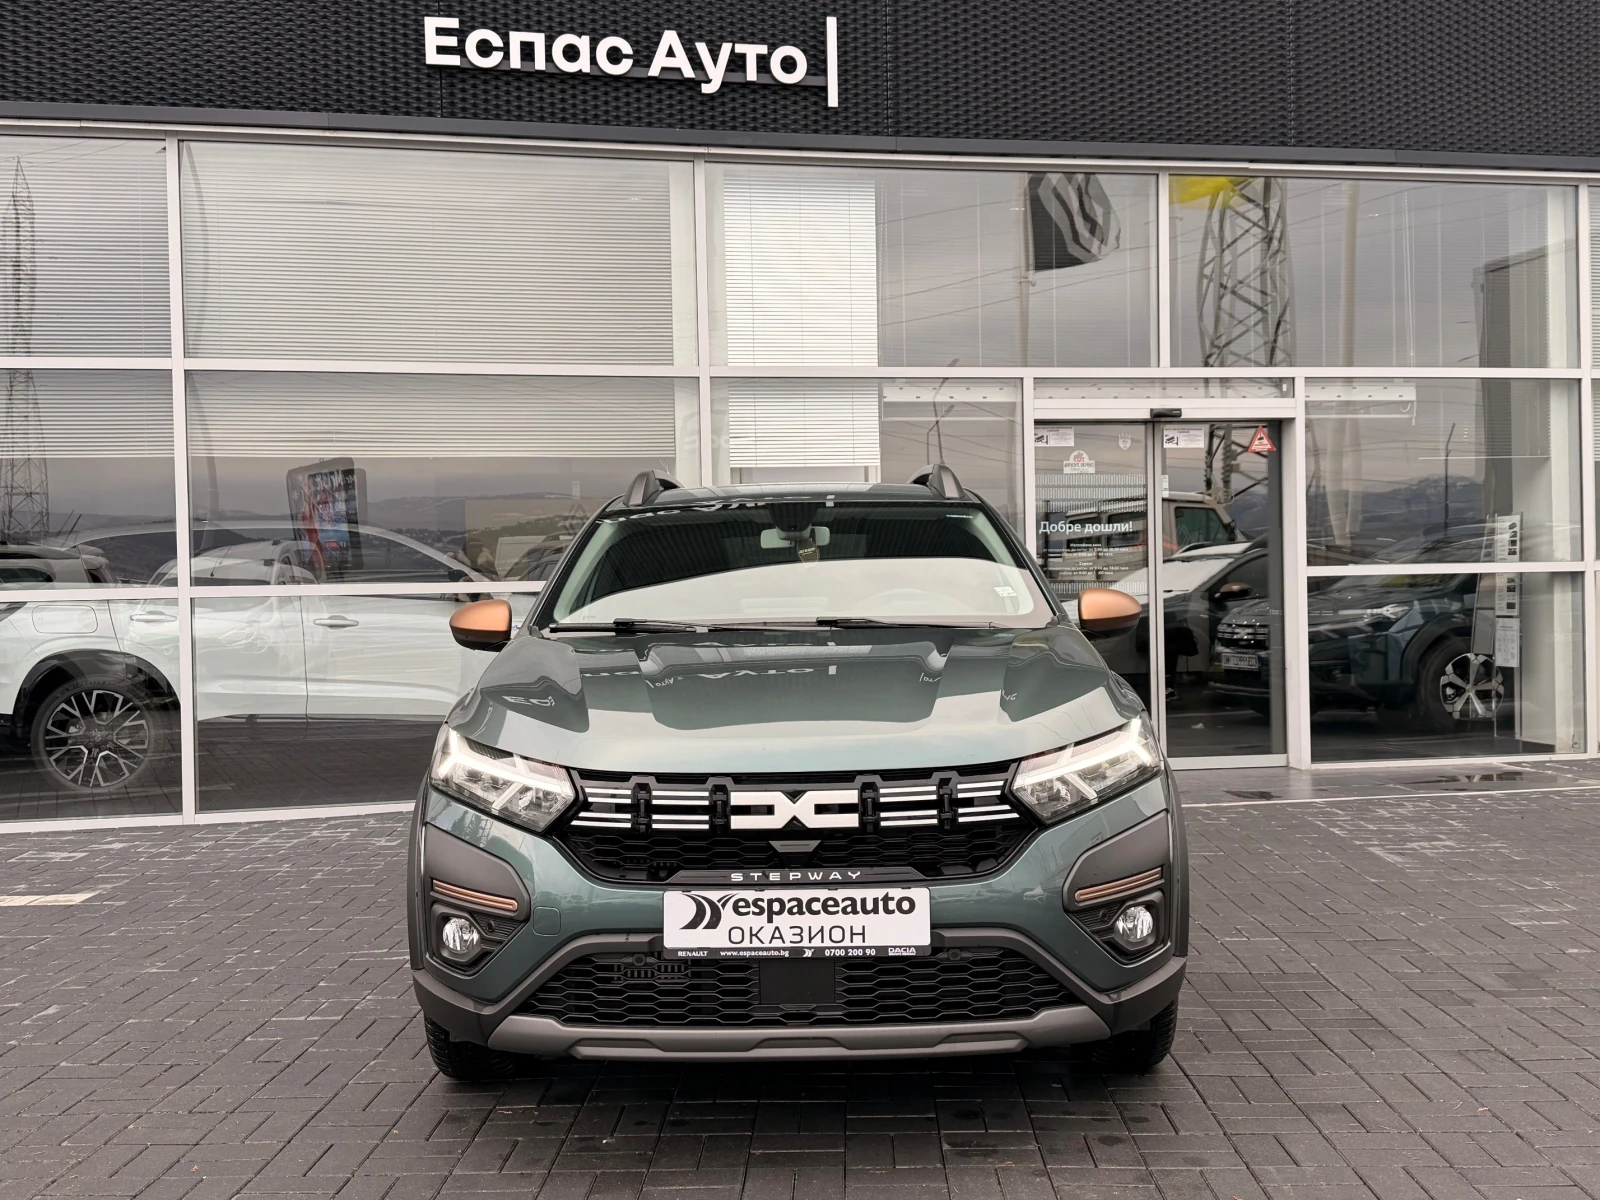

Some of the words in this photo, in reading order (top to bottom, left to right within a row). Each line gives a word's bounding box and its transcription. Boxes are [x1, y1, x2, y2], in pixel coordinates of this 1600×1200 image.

[424, 16, 634, 76] Еспас
[647, 30, 808, 94] Ауто
[1038, 520, 1082, 535] Добре
[1084, 520, 1133, 534] дошли!
[730, 871, 862, 882] STEPWAY
[732, 891, 917, 924] espaceauto
[728, 925, 867, 945] ОКАЗИОН
[719, 949, 790, 958] www.espaceauto.bg
[824, 948, 846, 957] 0700
[847, 948, 864, 957] 200
[865, 948, 876, 956] 90
[888, 947, 916, 956] DACIA
